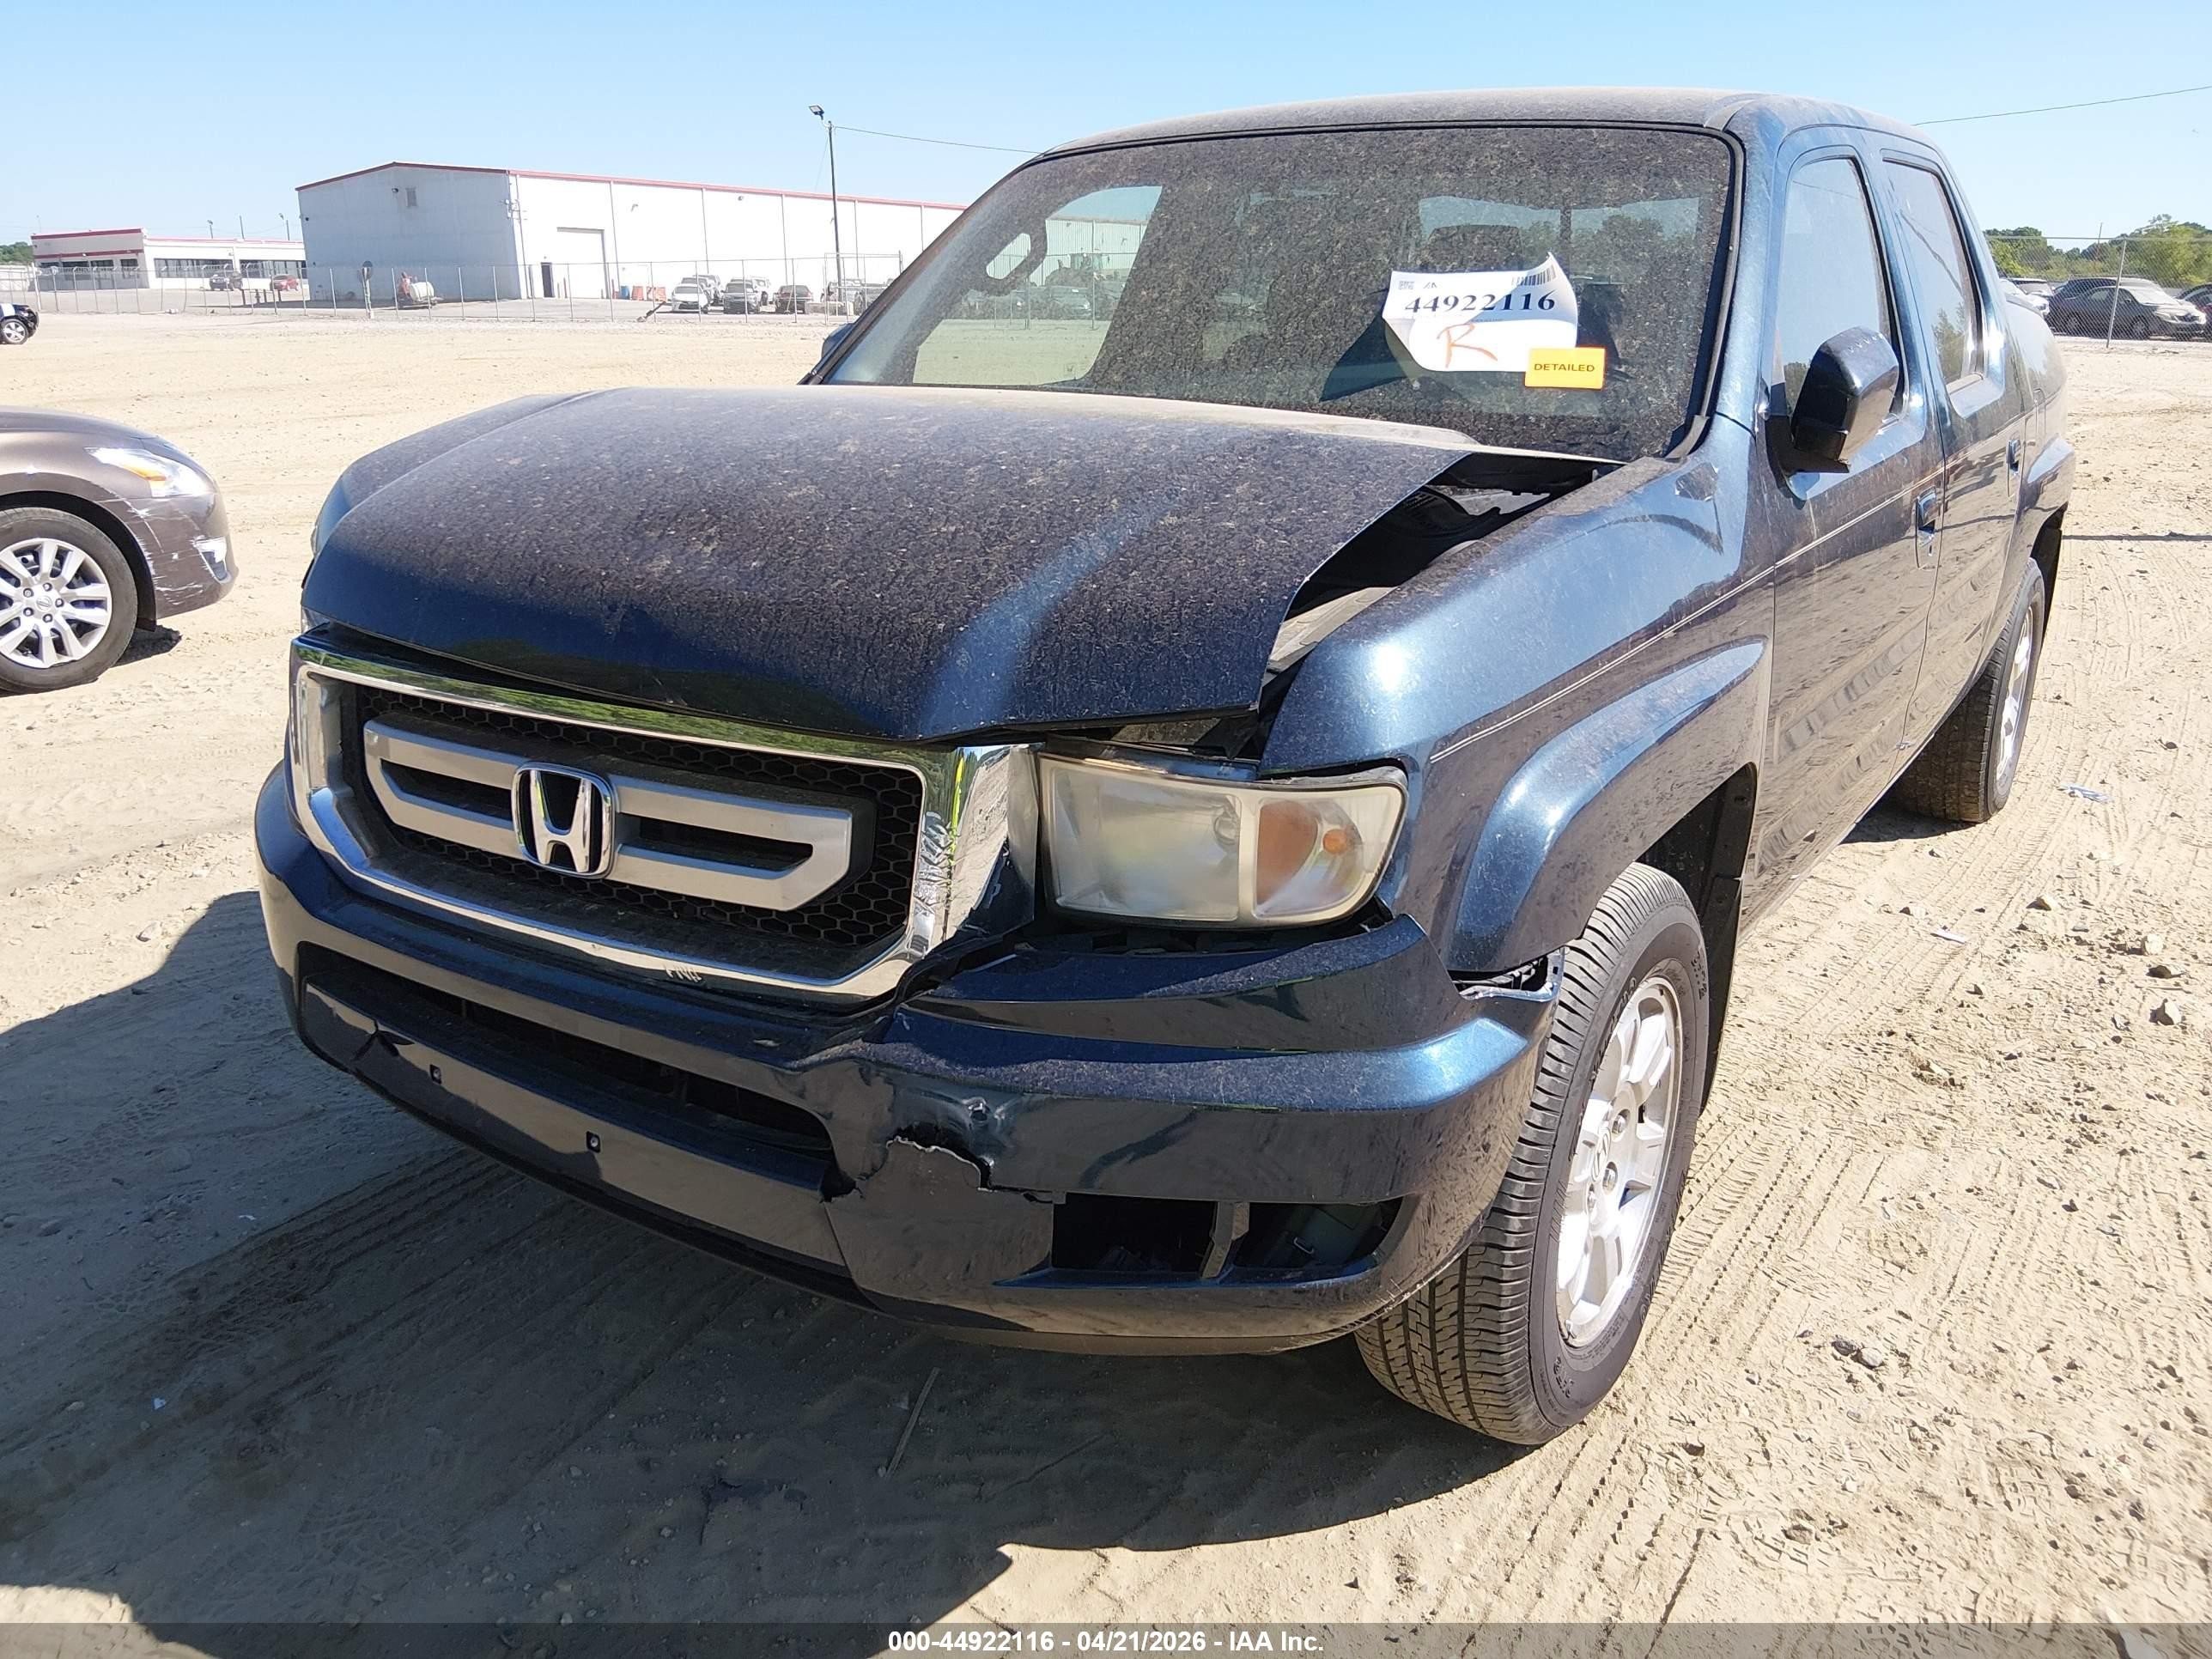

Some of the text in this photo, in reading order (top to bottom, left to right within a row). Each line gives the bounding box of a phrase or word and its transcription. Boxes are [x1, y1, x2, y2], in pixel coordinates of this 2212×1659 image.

[1405, 289, 1556, 313] 44922116
[1437, 323, 1498, 368] R
[1534, 362, 1595, 373] DETAILED
